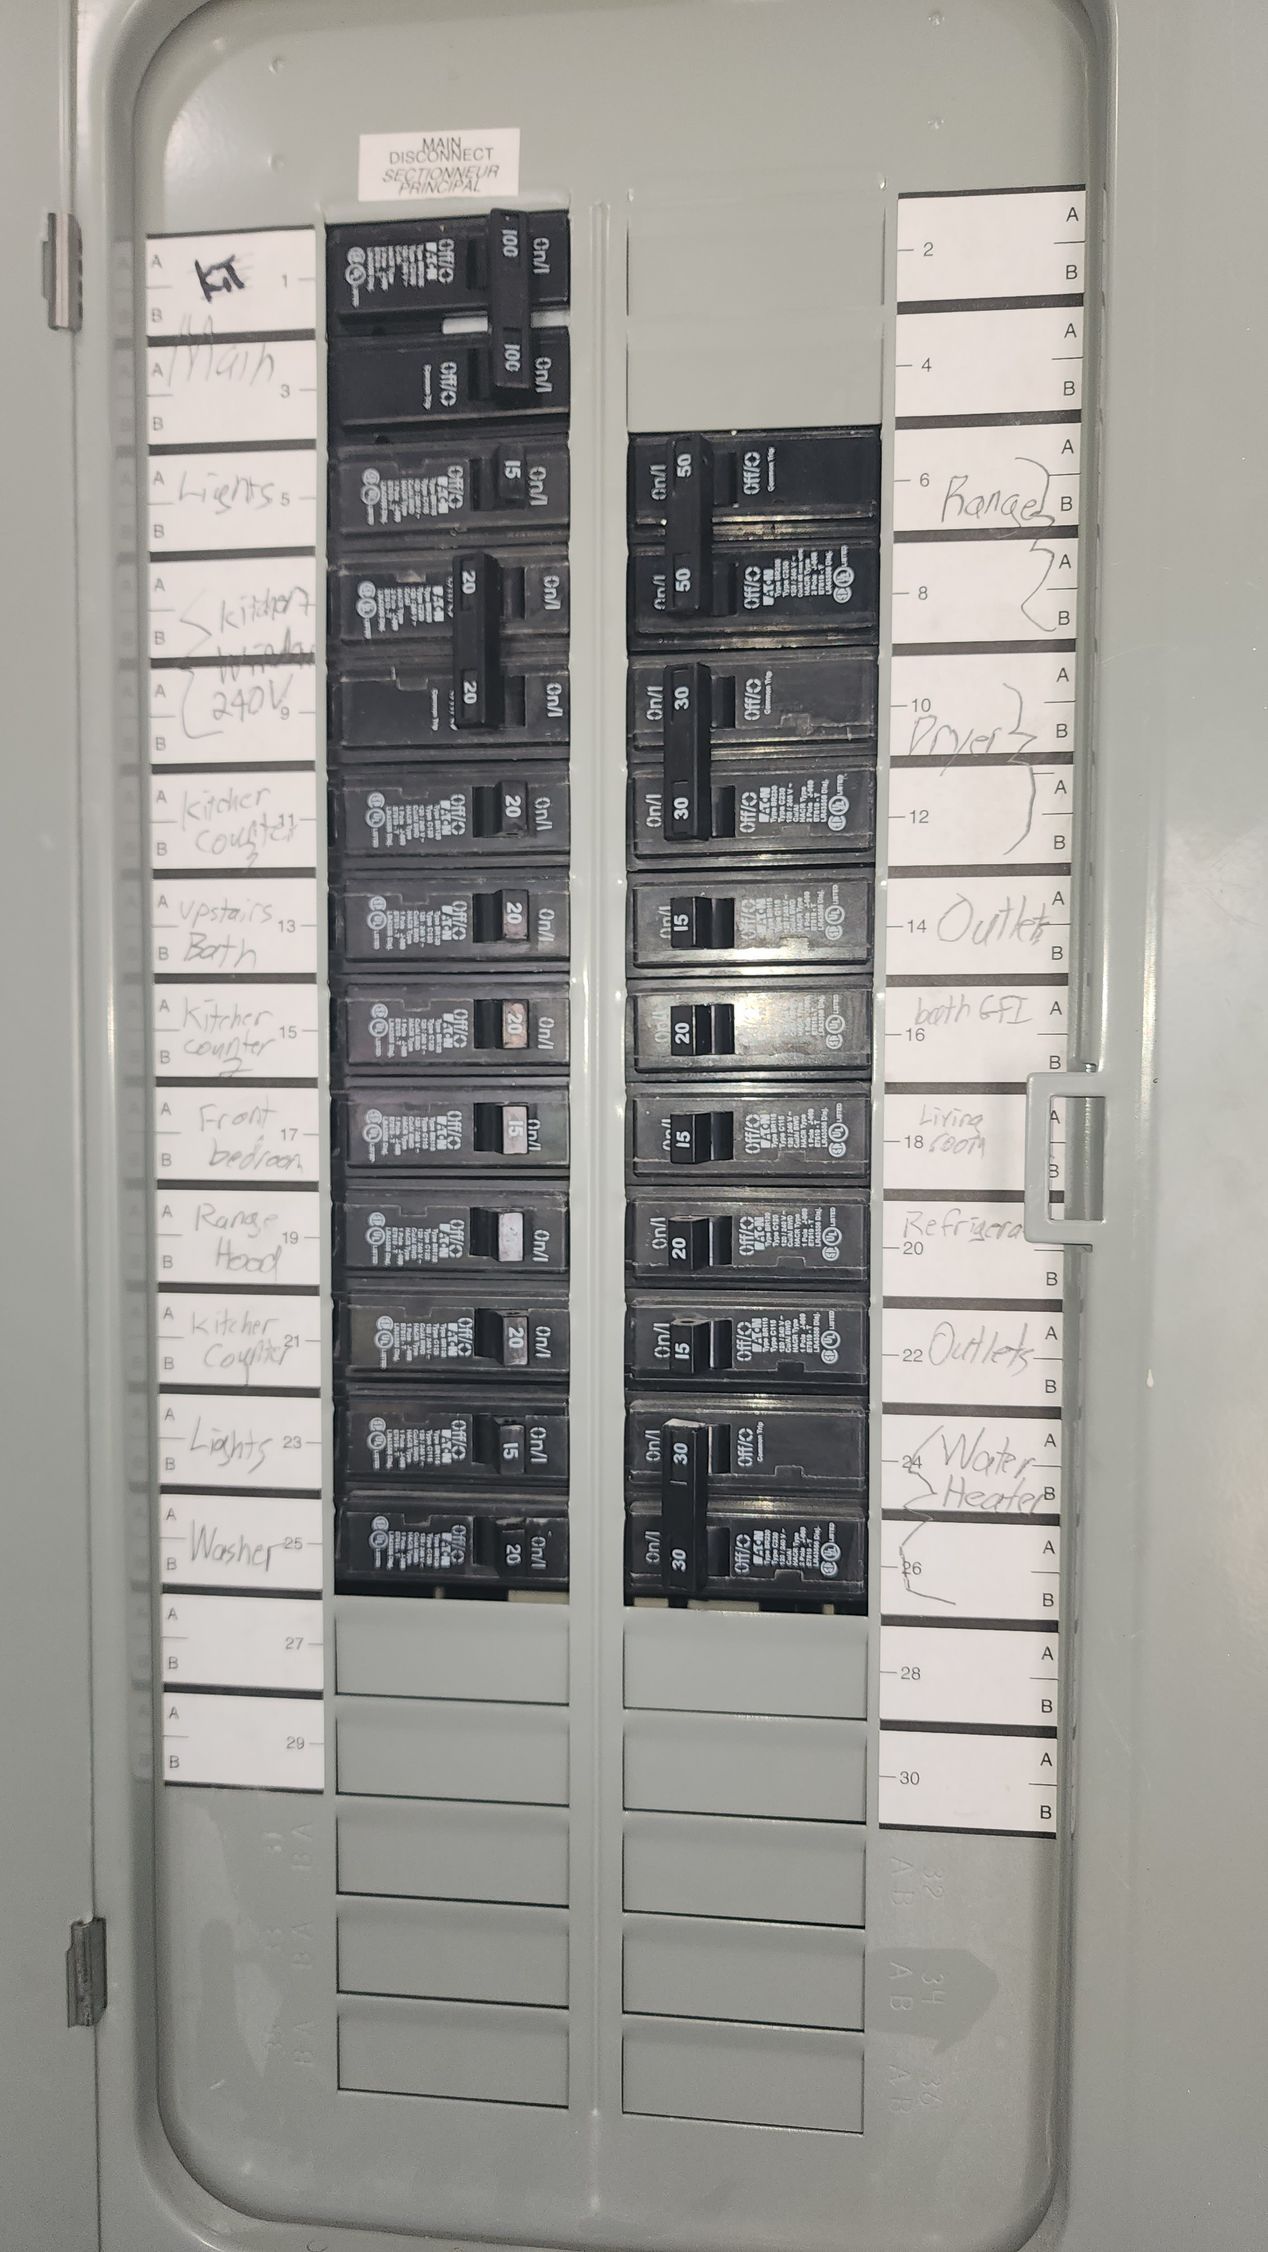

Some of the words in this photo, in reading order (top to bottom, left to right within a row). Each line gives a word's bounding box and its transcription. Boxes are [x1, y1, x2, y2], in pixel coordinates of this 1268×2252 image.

[422, 137, 462, 151] MAIN
[389, 148, 494, 165] DISCONNECT
[382, 165, 500, 183] SECTIONNEUR
[399, 178, 480, 196] PRINCIPAL
[1067, 207, 1078, 221] A
[502, 229, 518, 257] 100
[924, 242, 933, 256] 2
[152, 255, 162, 268] A
[1066, 265, 1077, 279] B
[283, 274, 288, 288] 1
[151, 308, 162, 323] B
[1064, 323, 1077, 338] A
[504, 344, 520, 372] 100
[922, 358, 931, 372] 4
[280, 384, 290, 398] 3
[1064, 381, 1075, 396] B
[1062, 439, 1074, 454] A
[505, 460, 521, 480] 15
[677, 454, 691, 478] 50
[920, 473, 929, 487] 6
[178, 470, 275, 515] Lights
[281, 492, 290, 506] 5
[941, 475, 1038, 528] Range
[1061, 496, 1072, 511] B
[1059, 554, 1071, 568] A
[462, 570, 476, 594] 20
[676, 568, 690, 592] 50
[918, 586, 928, 600] 8
[1059, 611, 1070, 625] B
[1057, 668, 1069, 682] A
[213, 673, 294, 723] 240V
[464, 681, 477, 704] 20
[675, 686, 689, 710] 30
[912, 699, 931, 712] 10
[280, 706, 290, 720] 9
[1057, 724, 1068, 738] B
[908, 714, 1002, 776] Dryer
[1055, 780, 1067, 794] A
[505, 795, 522, 818] 20
[674, 798, 689, 820] 30
[279, 814, 295, 828] 11
[910, 810, 929, 823] 12
[1054, 835, 1065, 849] B
[1052, 891, 1064, 905] A
[506, 902, 522, 924] 20
[278, 920, 295, 933] 13
[674, 914, 688, 931] 15
[908, 920, 926, 933] 14
[183, 932, 257, 968] Bath
[1052, 946, 1063, 960] B
[1050, 1001, 1062, 1015] A
[507, 1013, 523, 1035] 20
[280, 1025, 297, 1039] 15
[675, 1022, 690, 1044] 20
[906, 1028, 925, 1041] 16
[1050, 1056, 1060, 1069] B
[200, 1095, 277, 1132] Front
[1050, 1110, 1060, 1123] A
[281, 1128, 298, 1141] 17
[508, 1120, 524, 1138] 15
[676, 1131, 690, 1148] 15
[905, 1135, 923, 1148] 18
[1050, 1165, 1059, 1178] B
[195, 1203, 278, 1239] Range
[903, 1208, 1025, 1242] Refrigera
[281, 1232, 298, 1244] 19
[672, 1238, 686, 1260] 20
[903, 1241, 923, 1255] 20
[216, 1236, 283, 1281] Hood
[1047, 1272, 1057, 1286] B
[508, 1328, 524, 1349] 20
[1045, 1326, 1057, 1340] A
[284, 1334, 300, 1348] 21
[676, 1343, 690, 1360] 15
[903, 1349, 923, 1362] 22
[928, 1321, 1034, 1377] Outlets
[1046, 1379, 1056, 1393] B
[190, 1416, 274, 1474] Lights
[283, 1436, 302, 1449] 23
[1044, 1434, 1056, 1447] A
[503, 1442, 519, 1460] 15
[673, 1443, 688, 1464] 30
[942, 1426, 1036, 1478] Water
[902, 1455, 922, 1469] 24
[942, 1474, 1046, 1516] Heater
[1043, 1486, 1056, 1501] B
[166, 1508, 176, 1520] A
[191, 1519, 285, 1572] Washer
[283, 1537, 303, 1551] 25
[1043, 1540, 1055, 1554] A
[506, 1544, 521, 1567] 20
[672, 1549, 686, 1572] 30
[166, 1557, 177, 1571] B
[902, 1561, 922, 1575] 26
[1043, 1593, 1054, 1607] B
[167, 1608, 177, 1620] A
[285, 1637, 304, 1650] 27
[1042, 1646, 1053, 1660] A
[168, 1656, 178, 1669] B
[901, 1667, 920, 1680] 28
[169, 1707, 179, 1719] A
[1042, 1699, 1052, 1713] B
[287, 1736, 304, 1750] 29
[170, 1755, 179, 1768] B
[1041, 1753, 1052, 1766] A
[900, 1771, 919, 1785] 30
[1041, 1805, 1051, 1819] B
